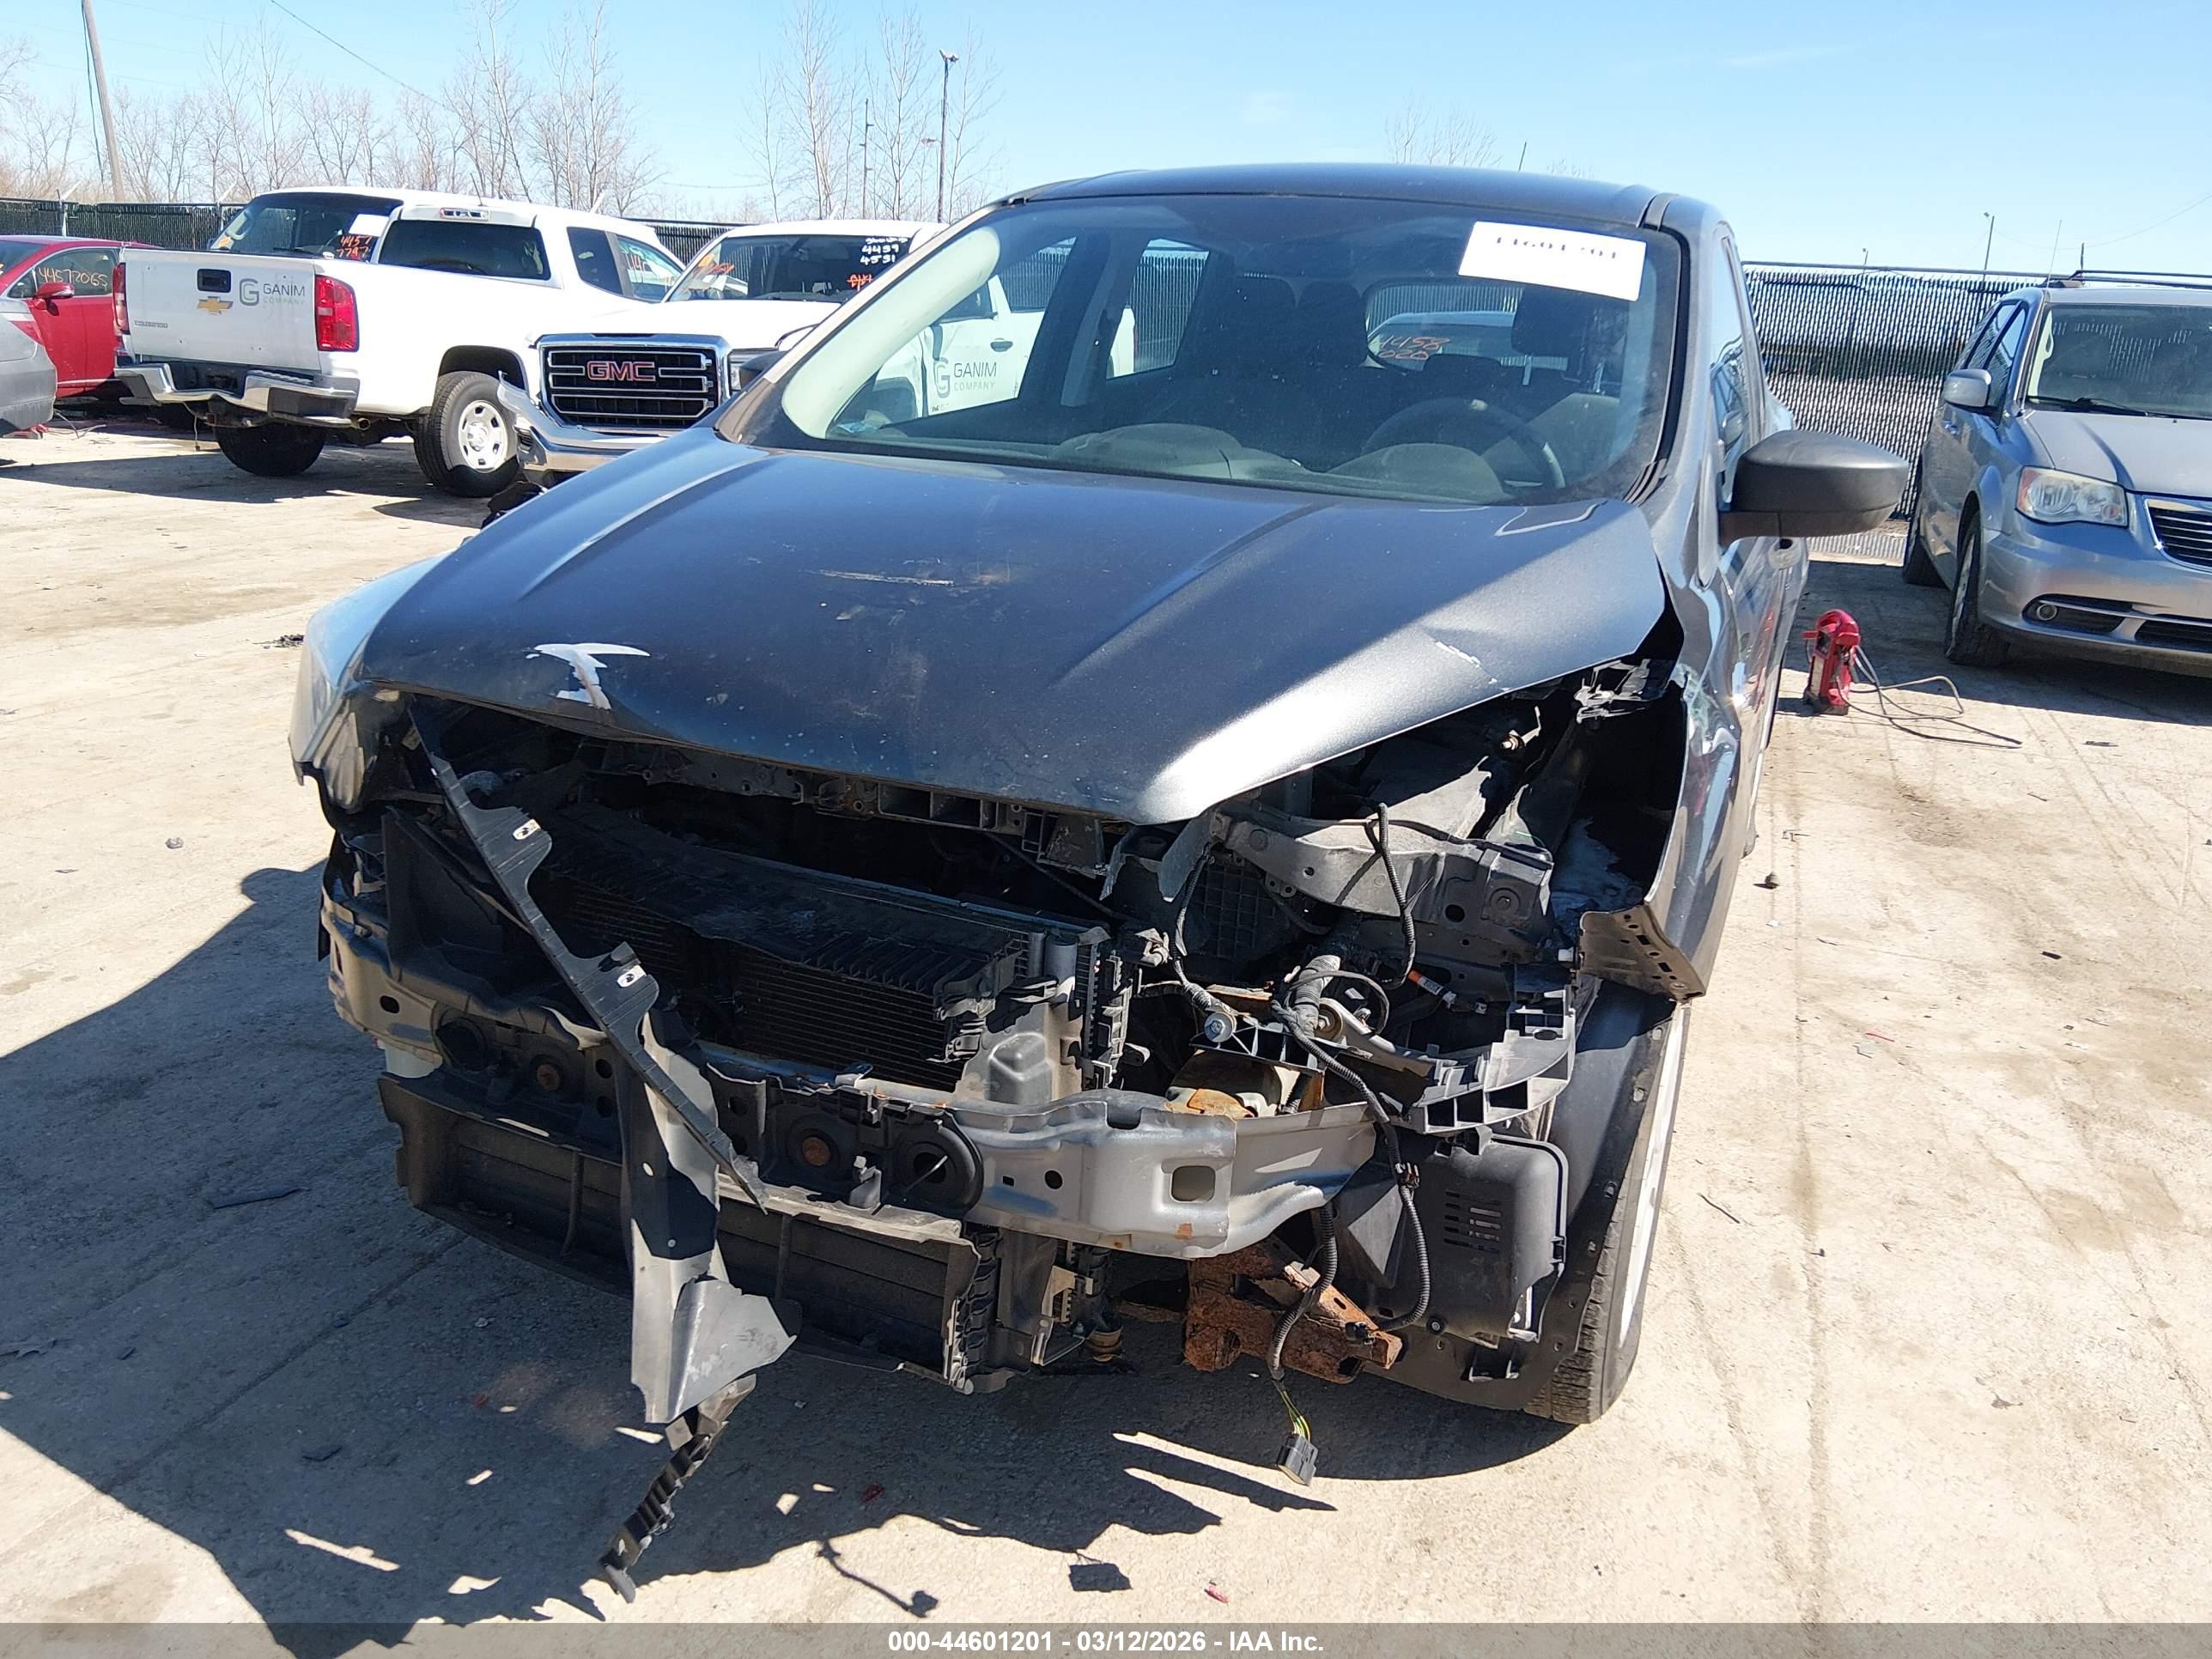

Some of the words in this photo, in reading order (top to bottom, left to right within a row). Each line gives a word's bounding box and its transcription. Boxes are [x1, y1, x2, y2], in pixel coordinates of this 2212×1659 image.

[340, 234, 373, 247] 4457
[38, 267, 108, 292] 44572065
[263, 283, 305, 296] GANIM
[586, 360, 656, 381] GMC
[953, 362, 997, 378] GANIM
[953, 381, 996, 392] COMPANY
